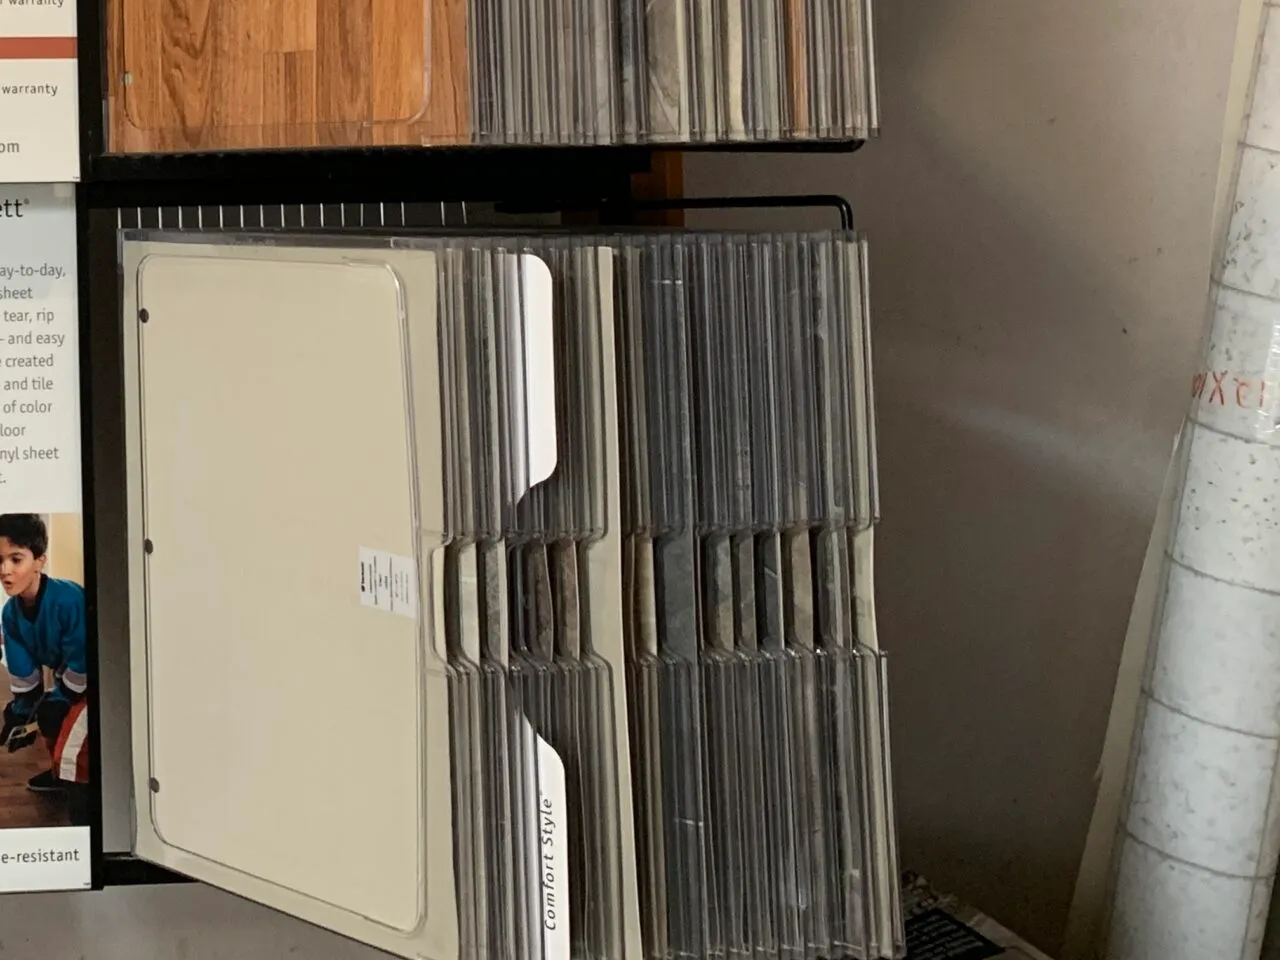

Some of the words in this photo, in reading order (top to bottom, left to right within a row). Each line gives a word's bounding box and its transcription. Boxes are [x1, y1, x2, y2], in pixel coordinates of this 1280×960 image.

[2, 82, 58, 96] warranty
[3, 309, 33, 324] tear,
[36, 308, 55, 324] rip
[7, 331, 32, 345] and
[35, 330, 65, 348] easy
[5, 353, 54, 368] created
[3, 377, 28, 391] and
[31, 377, 54, 390] tile
[3, 400, 17, 415] of
[19, 400, 52, 414] color
[22, 446, 59, 460] sheet
[540, 798, 556, 846] Style
[542, 854, 556, 931] Comfort
